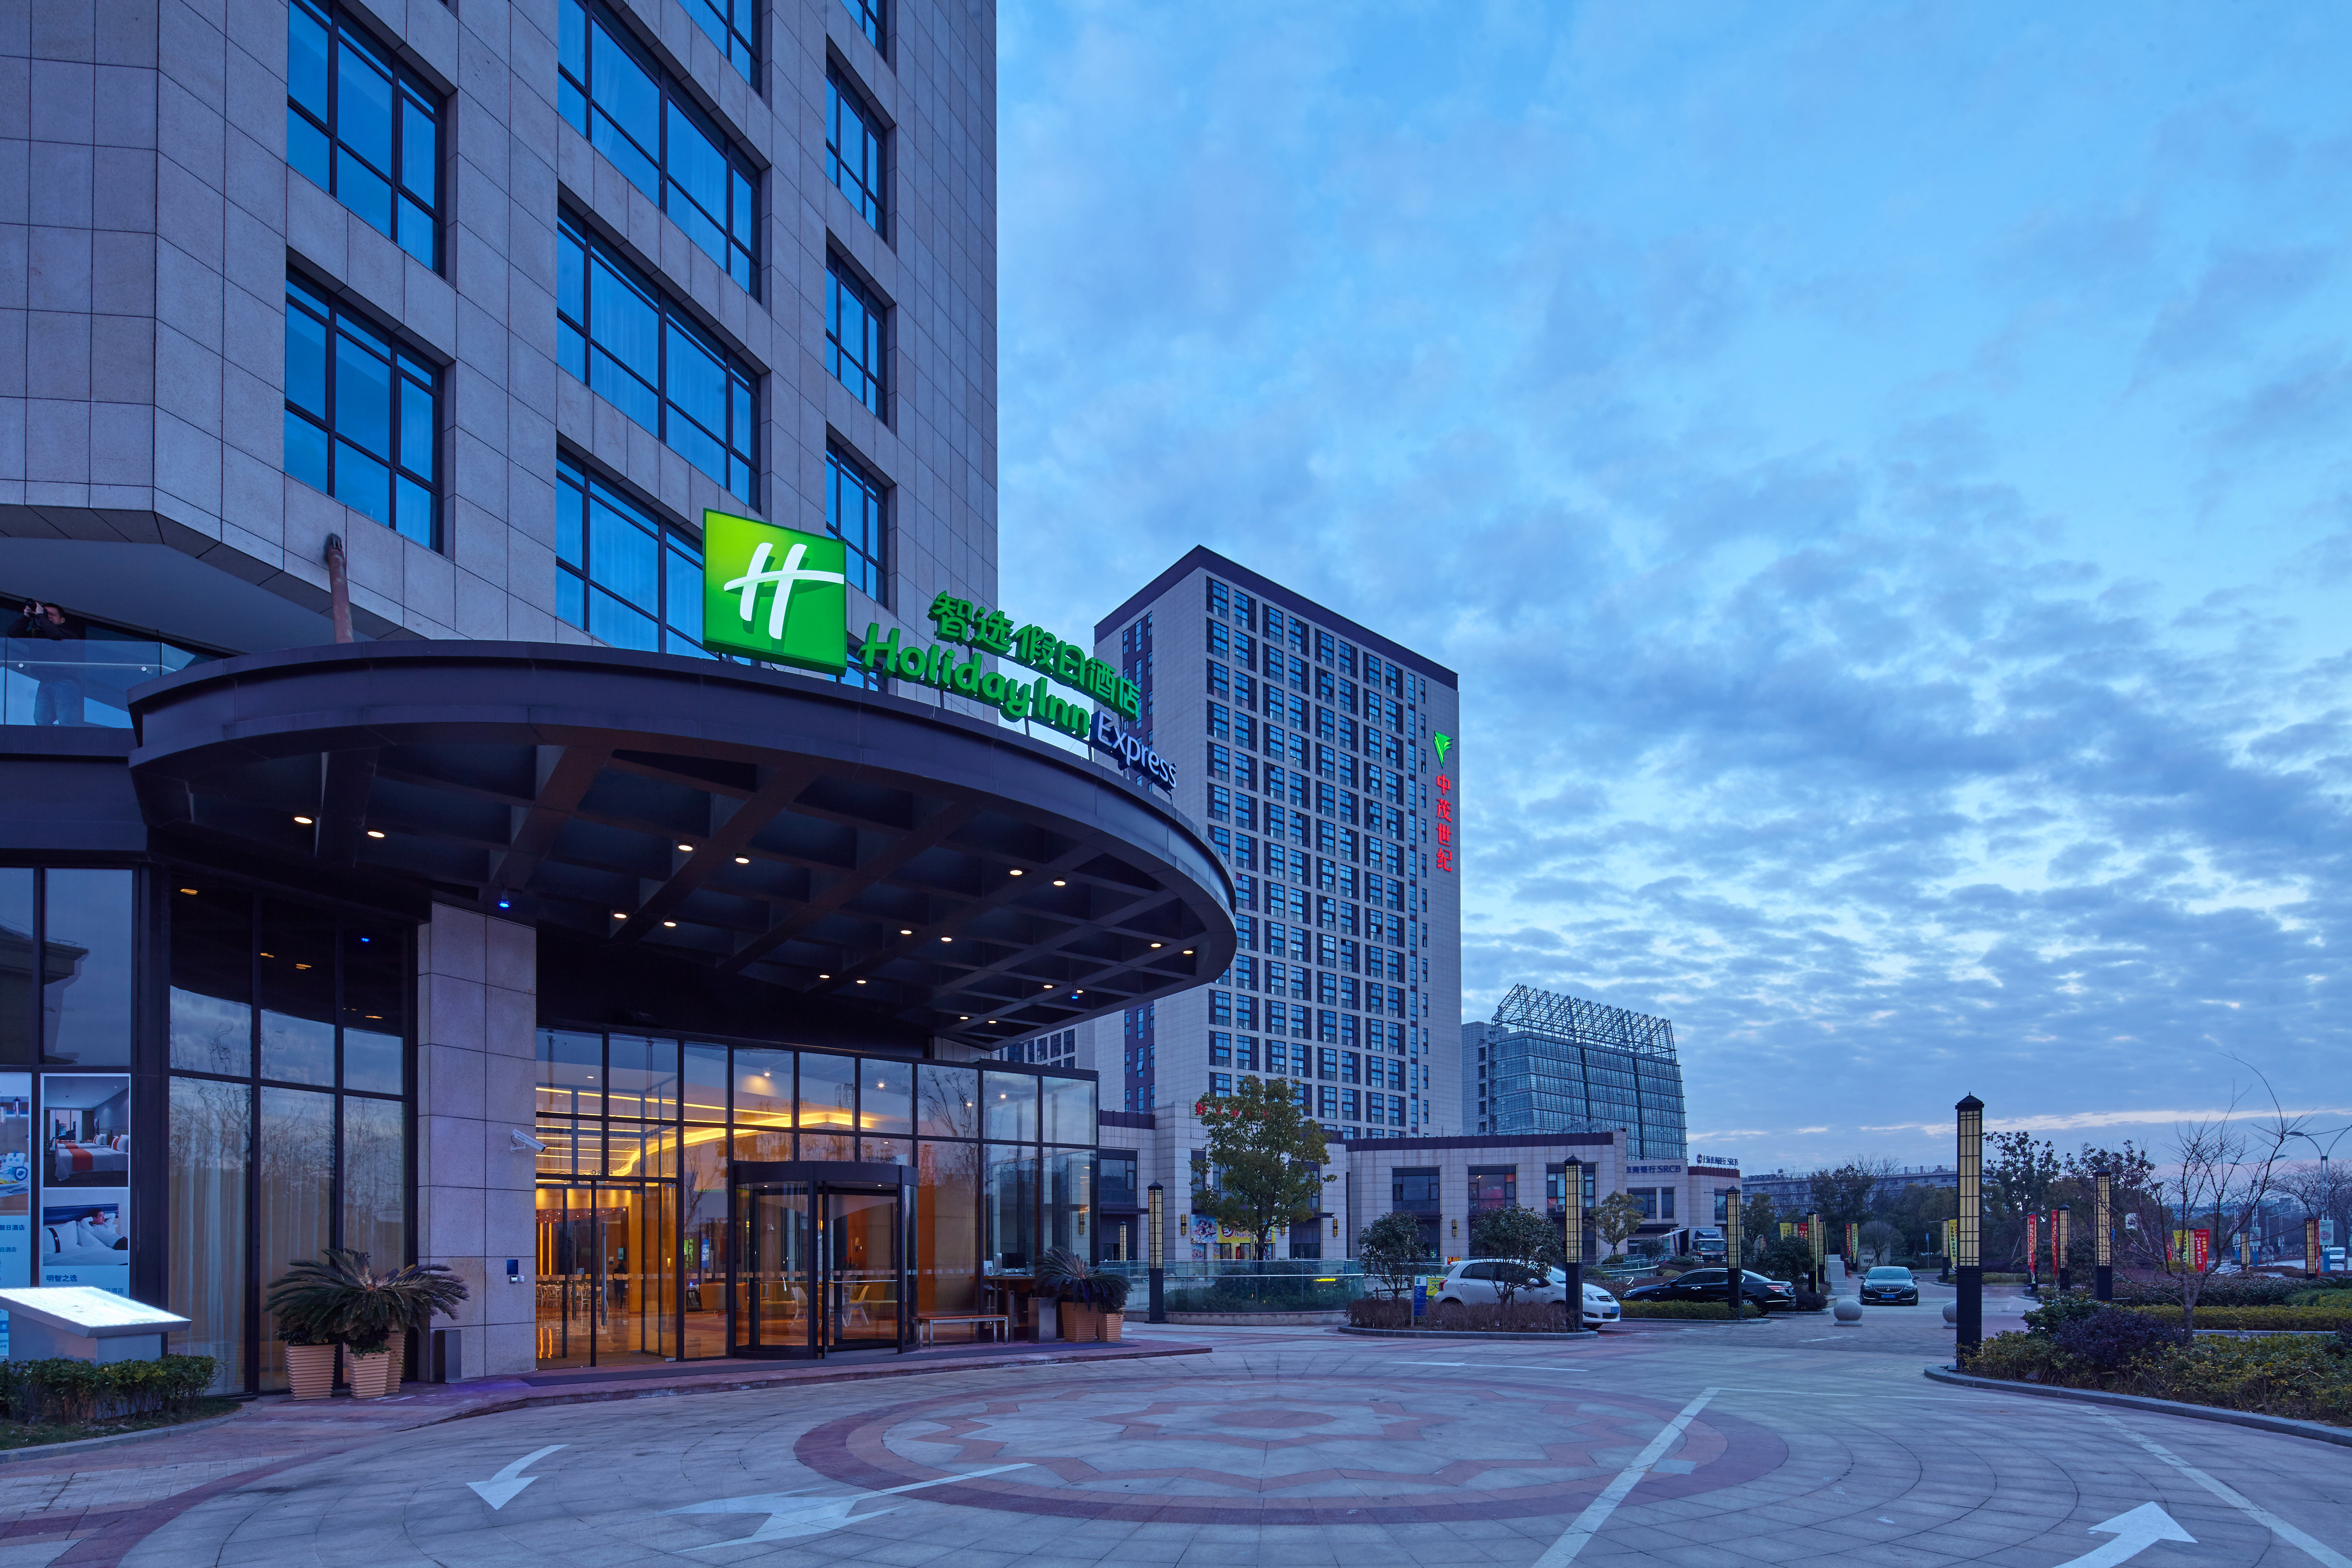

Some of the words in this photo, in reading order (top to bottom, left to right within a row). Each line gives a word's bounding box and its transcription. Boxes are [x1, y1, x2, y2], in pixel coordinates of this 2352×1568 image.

[857, 623, 1031, 722] Holiday
[1032, 676, 1090, 738] Inn
[927, 591, 1141, 722] 智选假日酒店
[1090, 710, 1177, 792] Express
[1436, 774, 1452, 872] 中茂世纪
